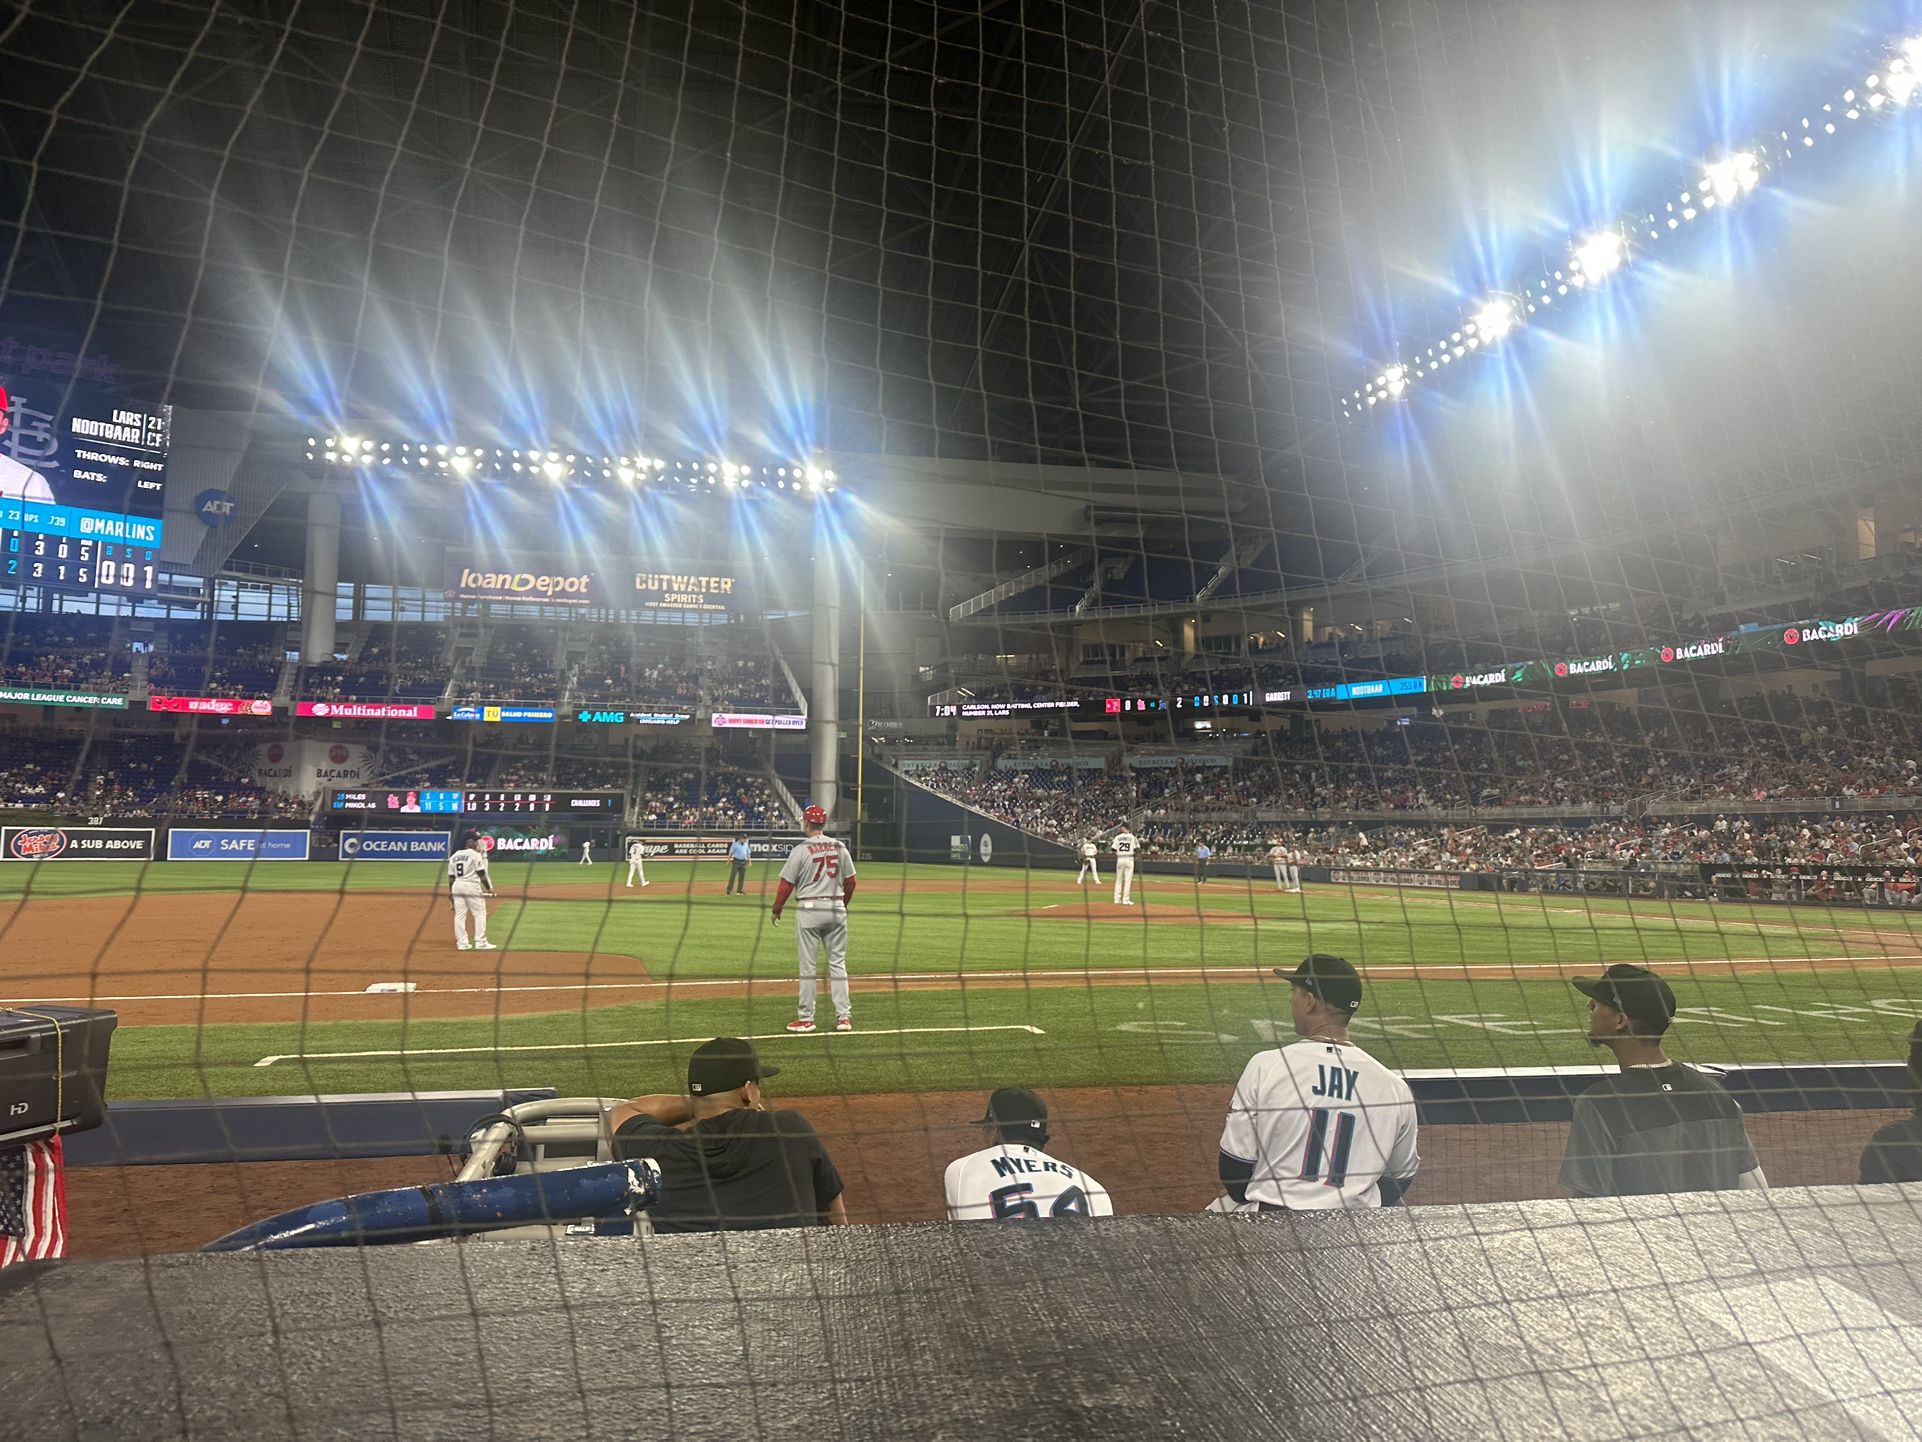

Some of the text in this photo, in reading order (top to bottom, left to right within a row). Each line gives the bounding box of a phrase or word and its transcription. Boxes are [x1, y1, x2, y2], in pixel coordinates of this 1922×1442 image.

[112, 410, 162, 430] LARS 21
[72, 418, 162, 447] NOOTBAAR CF
[75, 450, 164, 471] THROWS: RIGHT
[74, 470, 162, 490] BATS: LEFT
[202, 502, 234, 516] ADT
[8, 510, 20, 520] 23
[80, 517, 155, 541] @MARLINS
[34, 541, 44, 555] 3
[80, 546, 90, 561] 5
[8, 560, 88, 582] 2 3 1 5
[144, 566, 154, 589] 1
[460, 568, 590, 596] loanDepot
[636, 573, 732, 594] CUTWATER
[664, 593, 704, 603] SPIRITS
[1802, 617, 1859, 641] BACARDÍ
[1676, 639, 1724, 660] BACARDÍ
[1570, 655, 1613, 675] BACARDÍ
[31, 693, 64, 702] LEAGUE
[66, 695, 100, 704] CANCER
[101, 697, 123, 706] CARE
[1176, 696, 1182, 708] 2
[1243, 693, 1248, 704] 1
[1265, 691, 1291, 702] GARRETT
[330, 704, 418, 718] Multinational
[592, 711, 624, 722] AMG
[936, 706, 956, 716] 7:04
[316, 768, 360, 780] BACARDÍ
[500, 803, 504, 811] 2
[514, 803, 520, 811] 2
[88, 816, 104, 826] 387
[70, 840, 143, 849] A SUB ABOVE
[193, 841, 212, 850] ADT
[220, 840, 255, 850] SAFE
[362, 841, 446, 852] OCEAN BANK
[497, 834, 554, 850] BACARDÍ
[1119, 842, 1130, 852] 29
[457, 863, 463, 876] 9
[812, 854, 840, 882] 75
[1312, 1064, 1360, 1102] JAY
[10, 1102, 28, 1116] HD
[1300, 1106, 1356, 1188] 11
[990, 1157, 1074, 1180] MYERS
